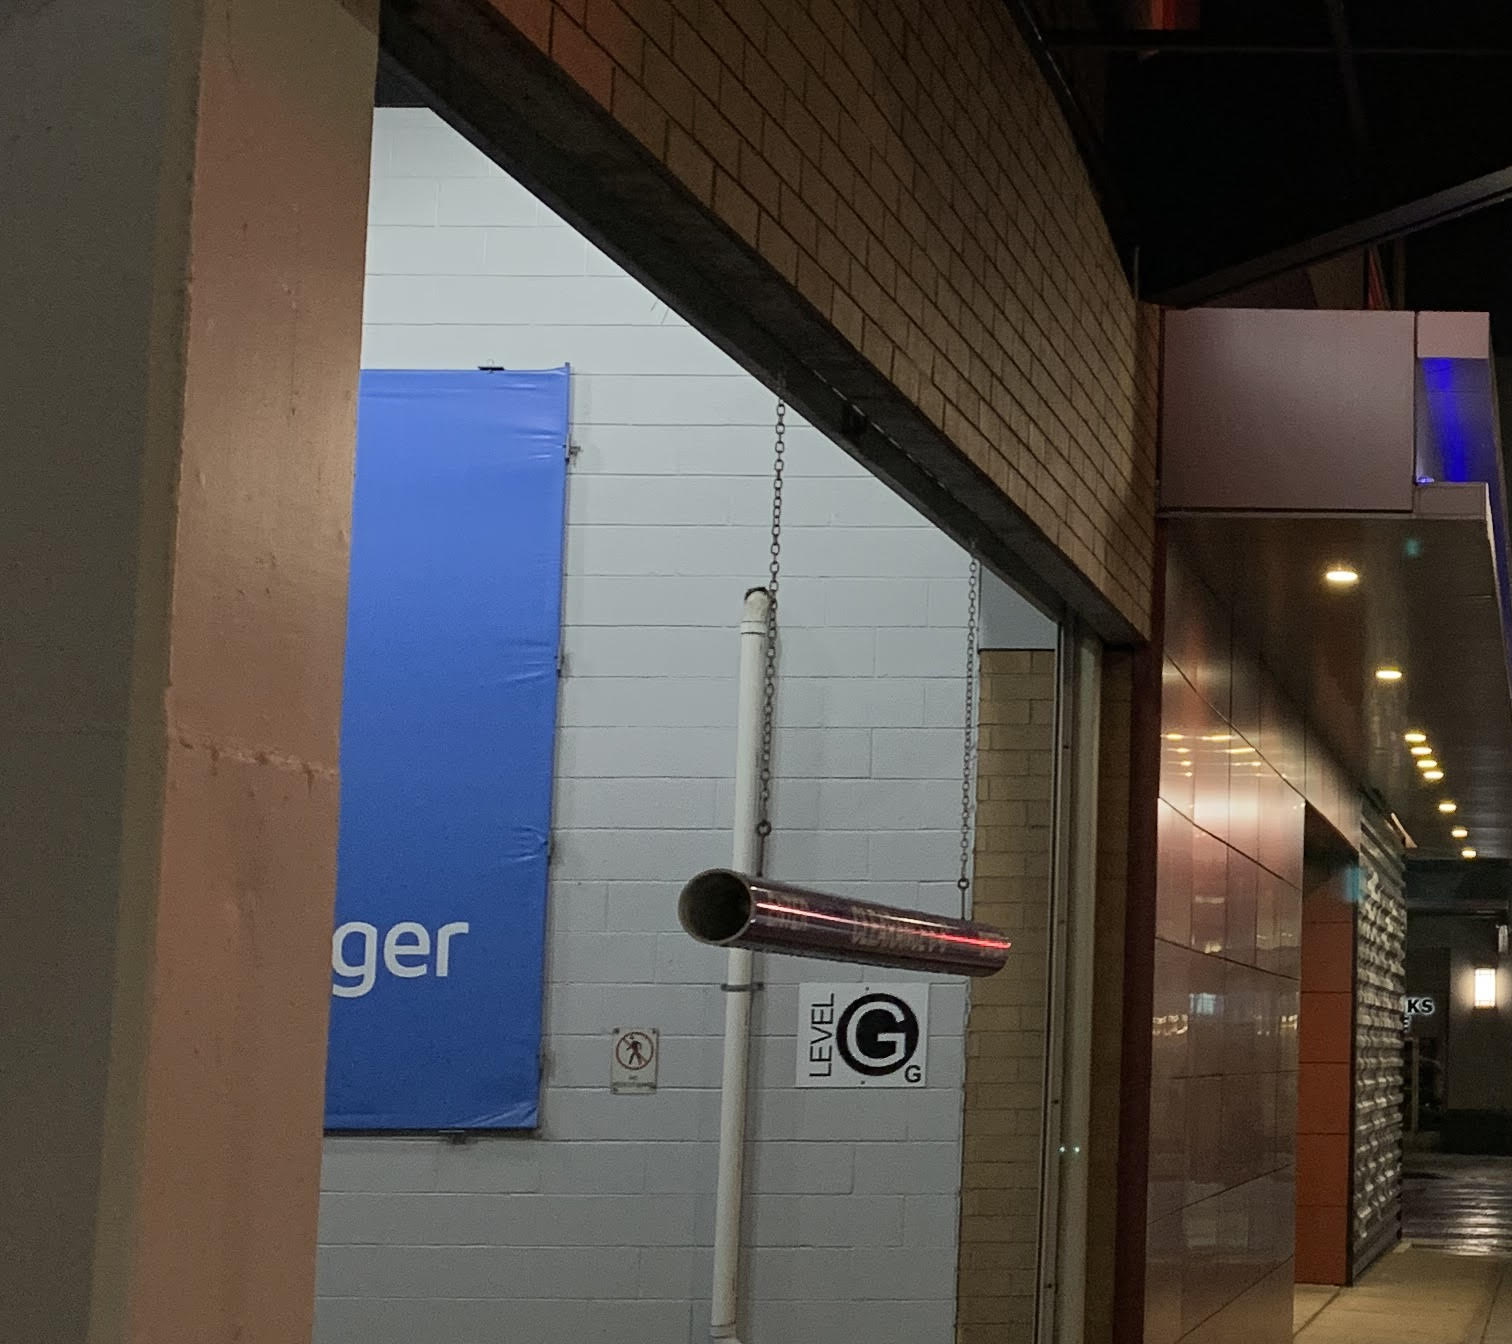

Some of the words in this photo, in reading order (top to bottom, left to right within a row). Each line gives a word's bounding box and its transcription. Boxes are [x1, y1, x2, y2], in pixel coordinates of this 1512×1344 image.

[809, 992, 834, 1078] LEVEL
[846, 1001, 906, 1068] G
[904, 1064, 922, 1083] G
